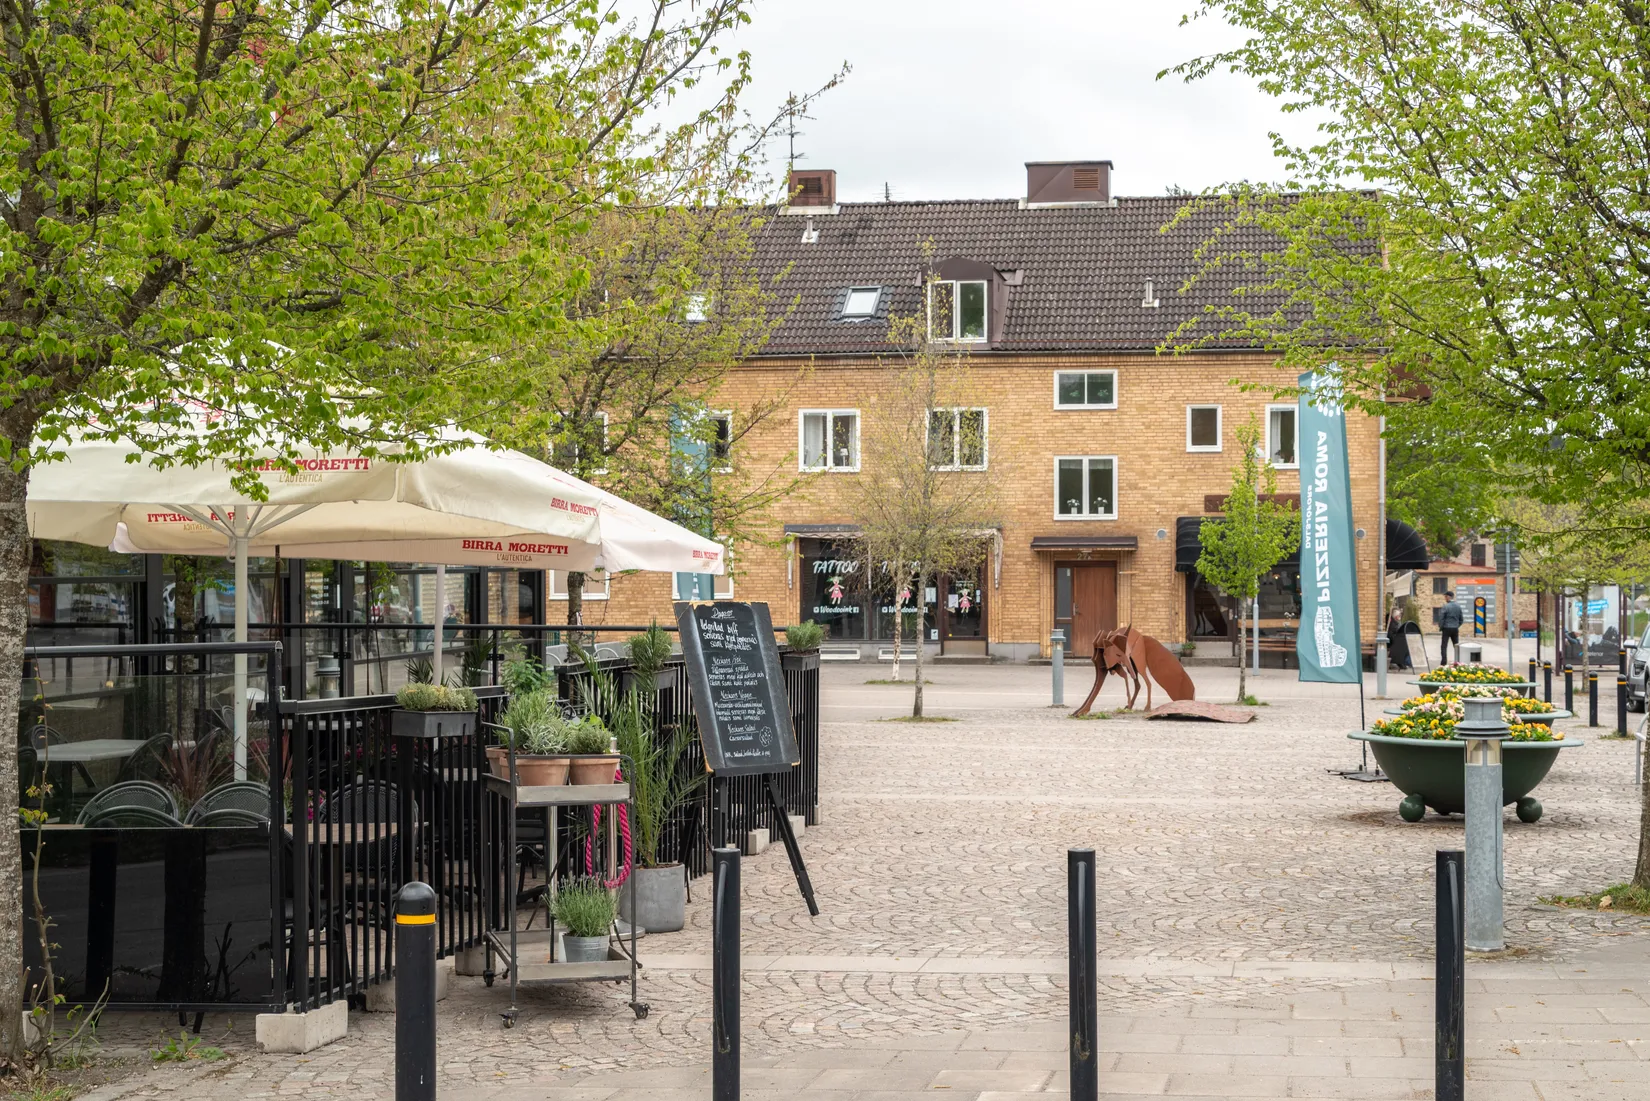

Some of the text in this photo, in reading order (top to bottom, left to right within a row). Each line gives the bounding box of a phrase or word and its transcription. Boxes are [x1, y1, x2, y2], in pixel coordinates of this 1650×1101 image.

[295, 458, 369, 471] MORETTI
[550, 497, 599, 517] BIRRA MORETTI
[462, 539, 569, 554] BIRRA MORETTI
[496, 553, 532, 562] L'AUTENTICA
[813, 559, 859, 574] TATTOO
